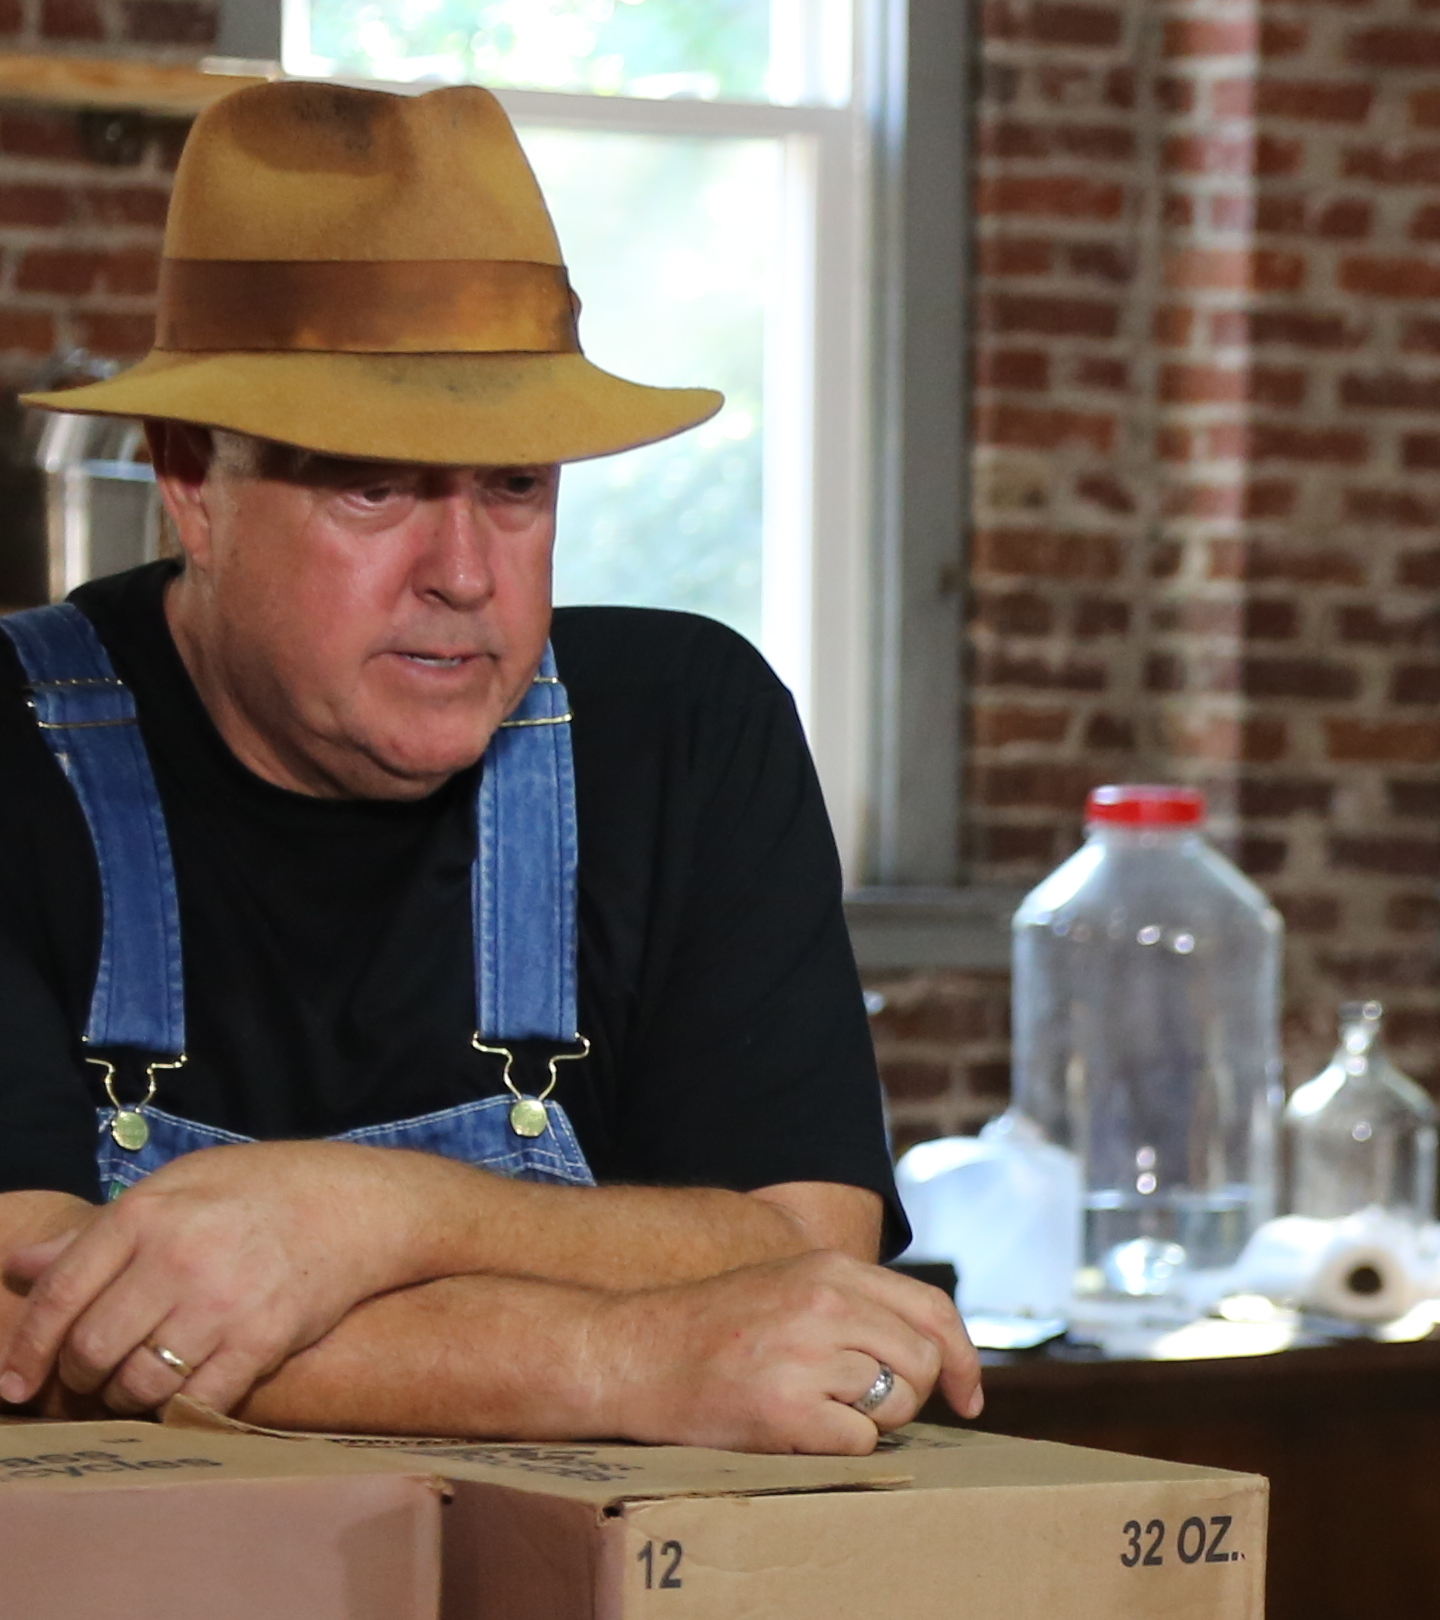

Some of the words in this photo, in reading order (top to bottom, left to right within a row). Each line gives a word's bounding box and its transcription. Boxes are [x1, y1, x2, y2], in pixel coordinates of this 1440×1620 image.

[637, 1539, 684, 1590] 12
[1121, 1518, 1166, 1567] 32
[1177, 1515, 1239, 1564] OZ.
